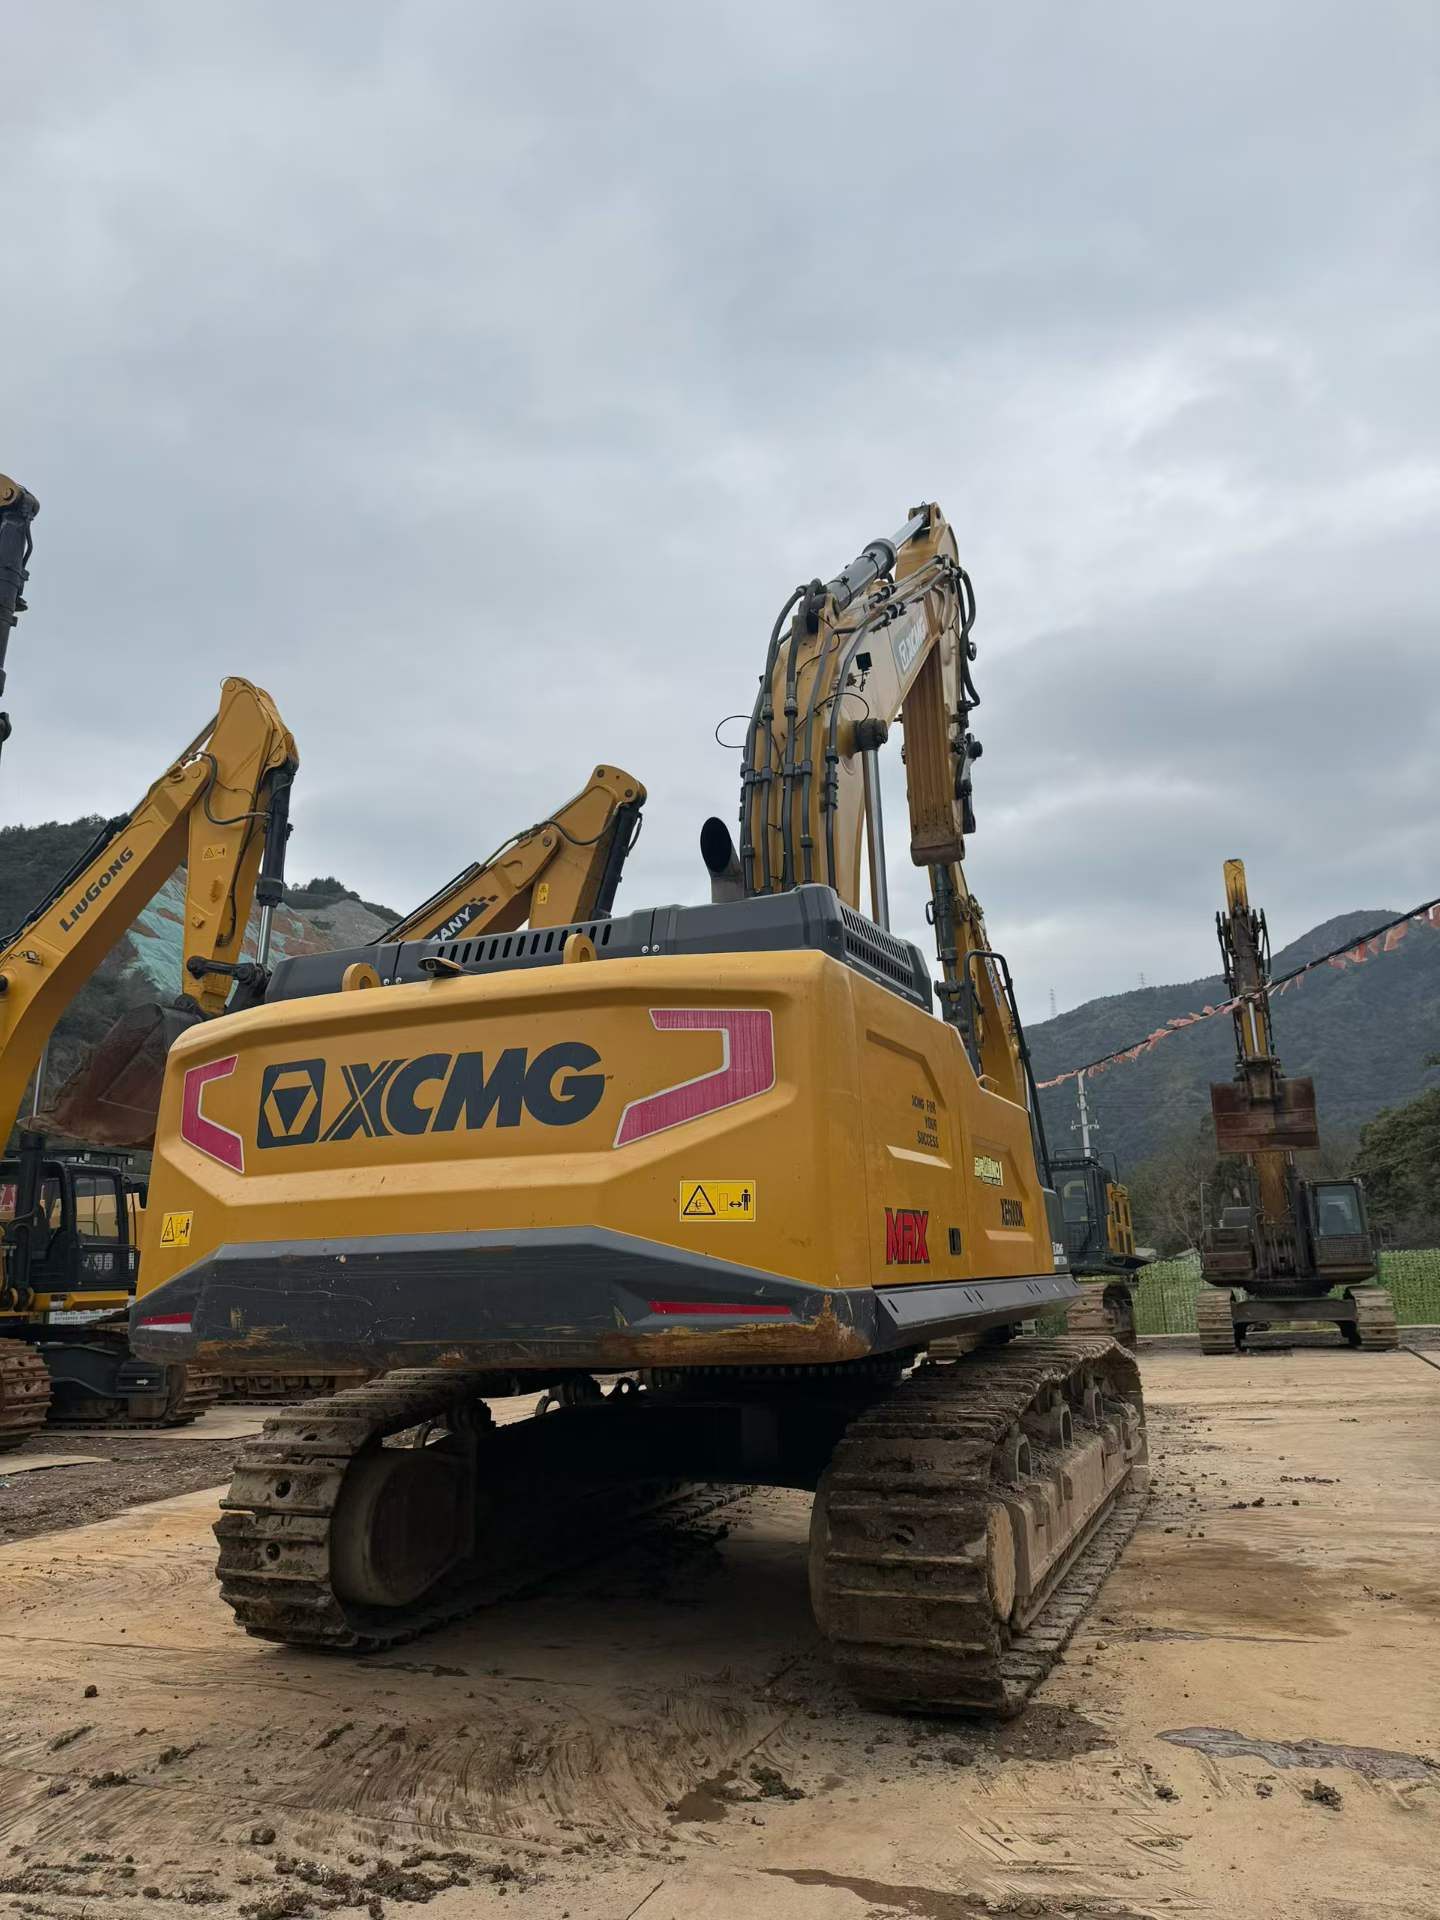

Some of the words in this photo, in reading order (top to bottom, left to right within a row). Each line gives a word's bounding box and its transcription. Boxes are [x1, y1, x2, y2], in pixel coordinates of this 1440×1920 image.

[59, 846, 135, 932] LIUGONG
[319, 1041, 606, 1143] XCMG
[917, 1131, 939, 1148] SUCCESS
[884, 1207, 930, 1265] MAX
